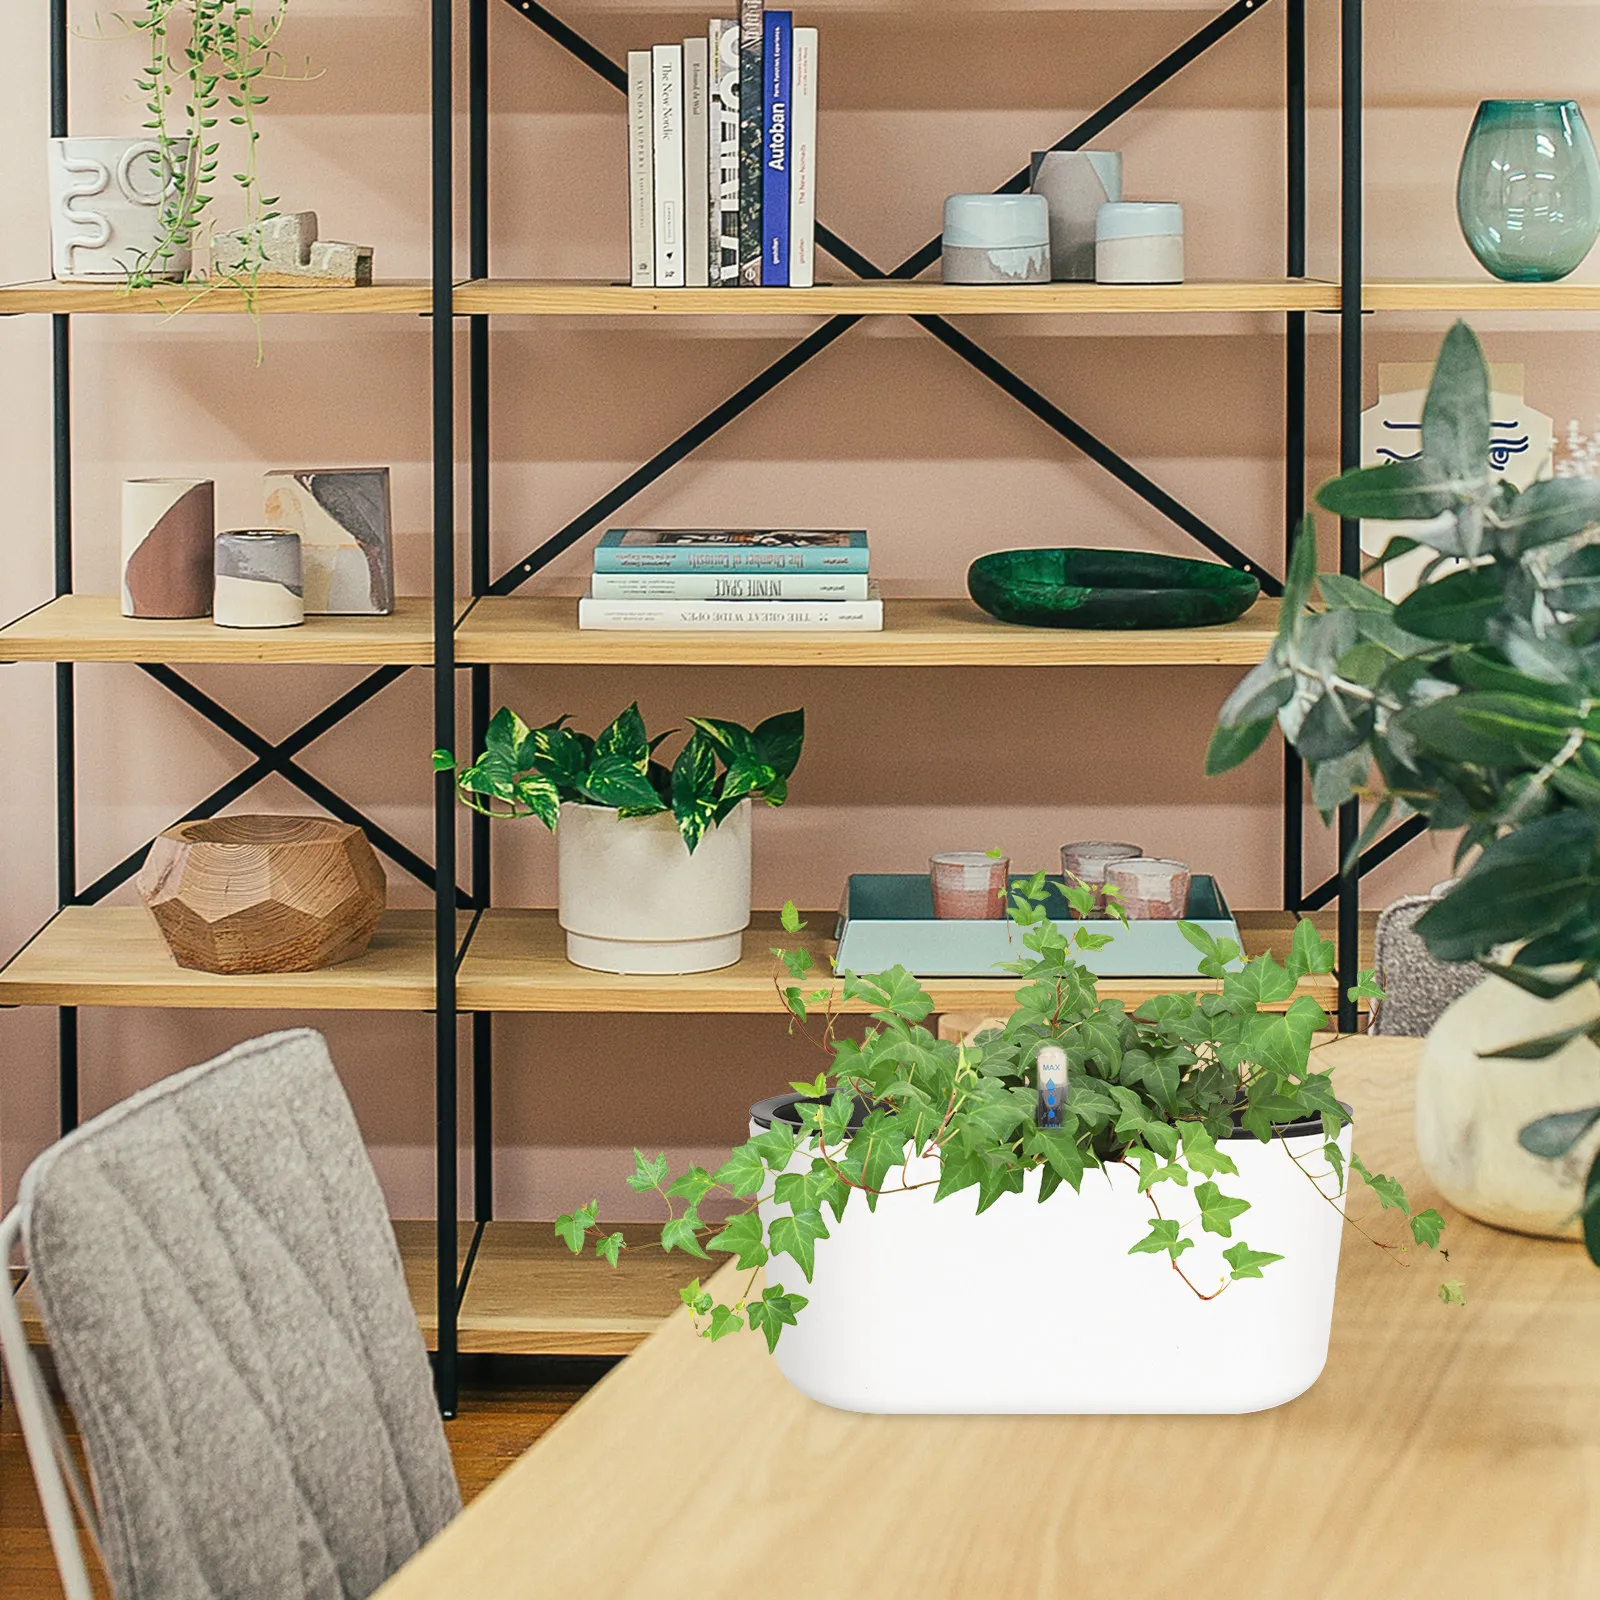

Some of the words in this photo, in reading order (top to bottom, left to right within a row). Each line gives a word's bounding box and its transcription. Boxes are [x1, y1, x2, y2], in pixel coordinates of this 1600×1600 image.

[662, 62, 673, 81] The
[662, 83, 673, 106] New
[662, 107, 674, 141] Nordic
[768, 103, 785, 171] Autoban
[637, 125, 645, 169] SUPPERS
[798, 174, 806, 190] New
[687, 553, 729, 569] Curiosity
[732, 554, 742, 568] of
[745, 554, 786, 568] Chamber
[788, 555, 804, 568] The
[714, 579, 743, 597] SPACE
[747, 579, 782, 597] INFINITE
[680, 612, 711, 622] OPEN
[711, 612, 744, 622] WIDE
[748, 612, 785, 622] GREAT
[787, 612, 812, 622] THE
